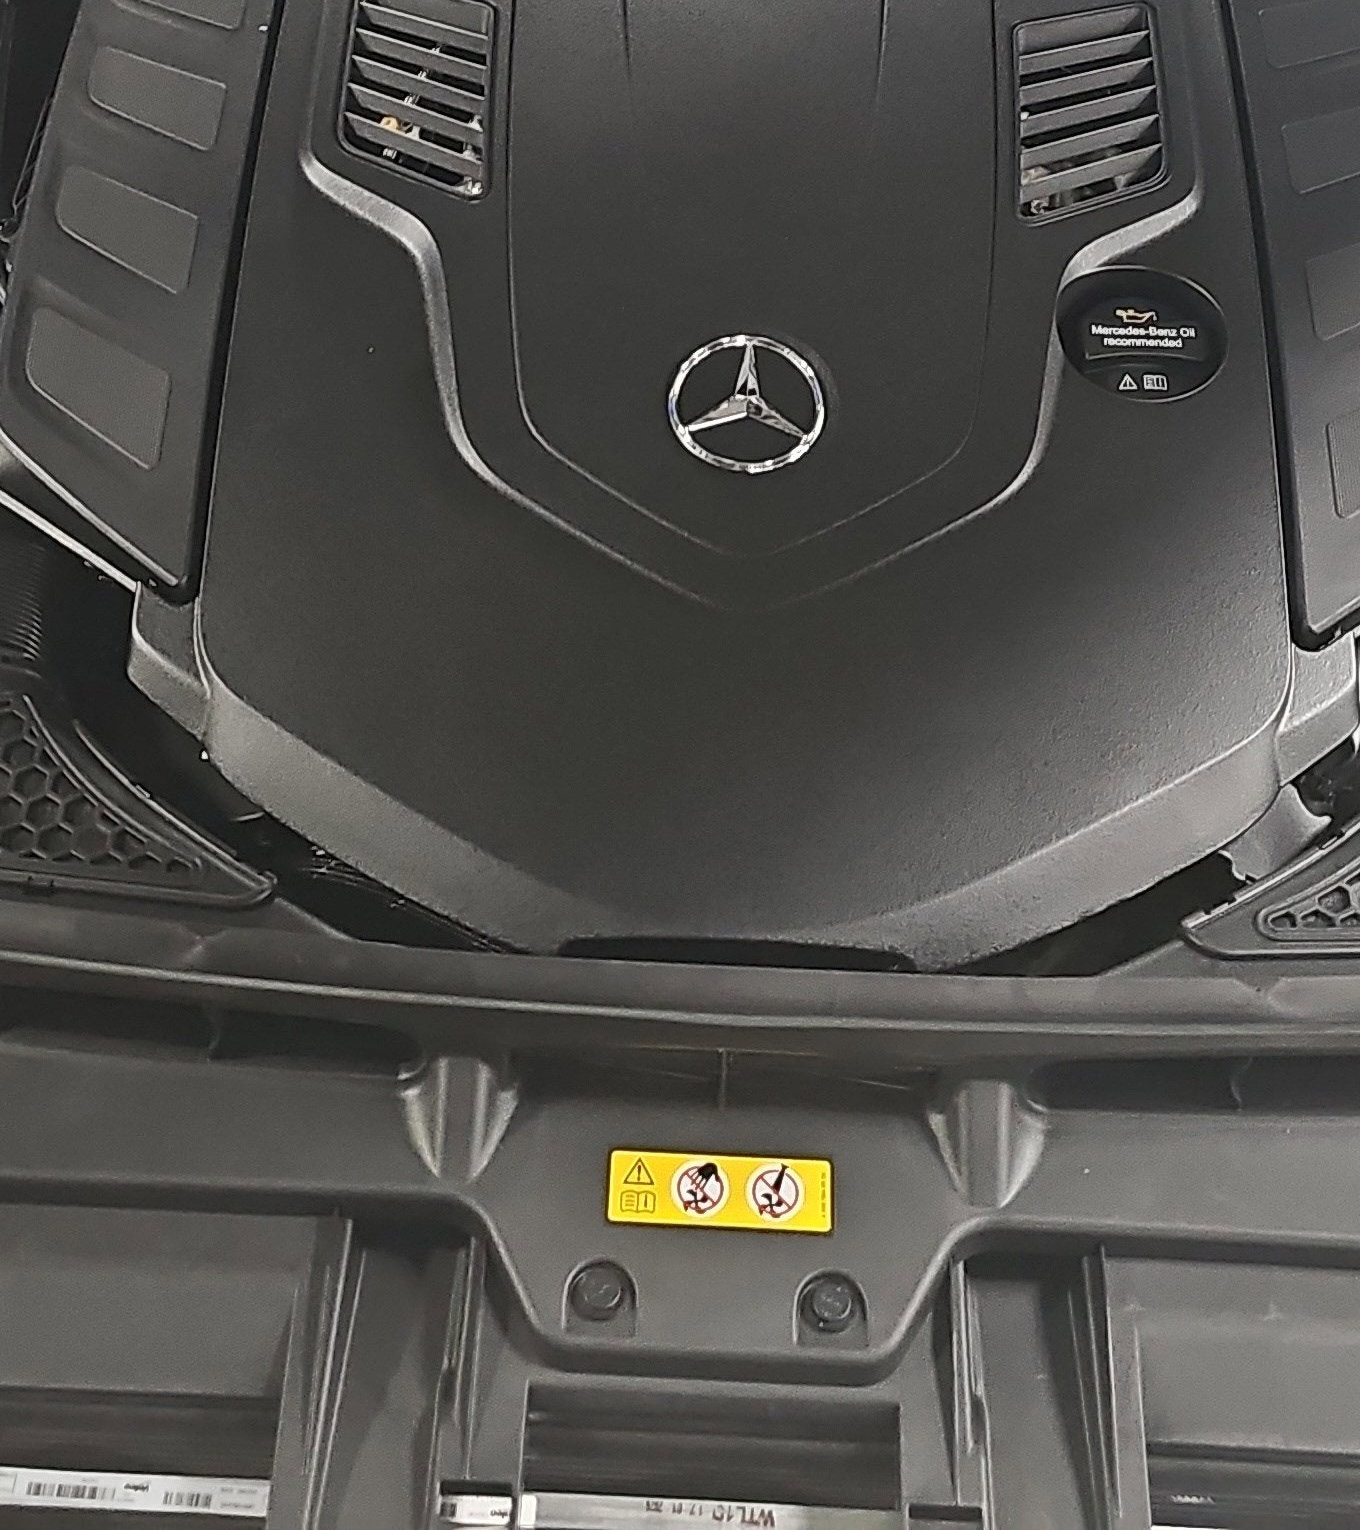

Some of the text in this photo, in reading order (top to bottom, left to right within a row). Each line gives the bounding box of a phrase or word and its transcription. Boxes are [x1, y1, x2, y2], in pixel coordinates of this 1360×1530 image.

[1091, 325, 1196, 338] Mercedes-Benz Oil
[1103, 337, 1183, 348] recommended
